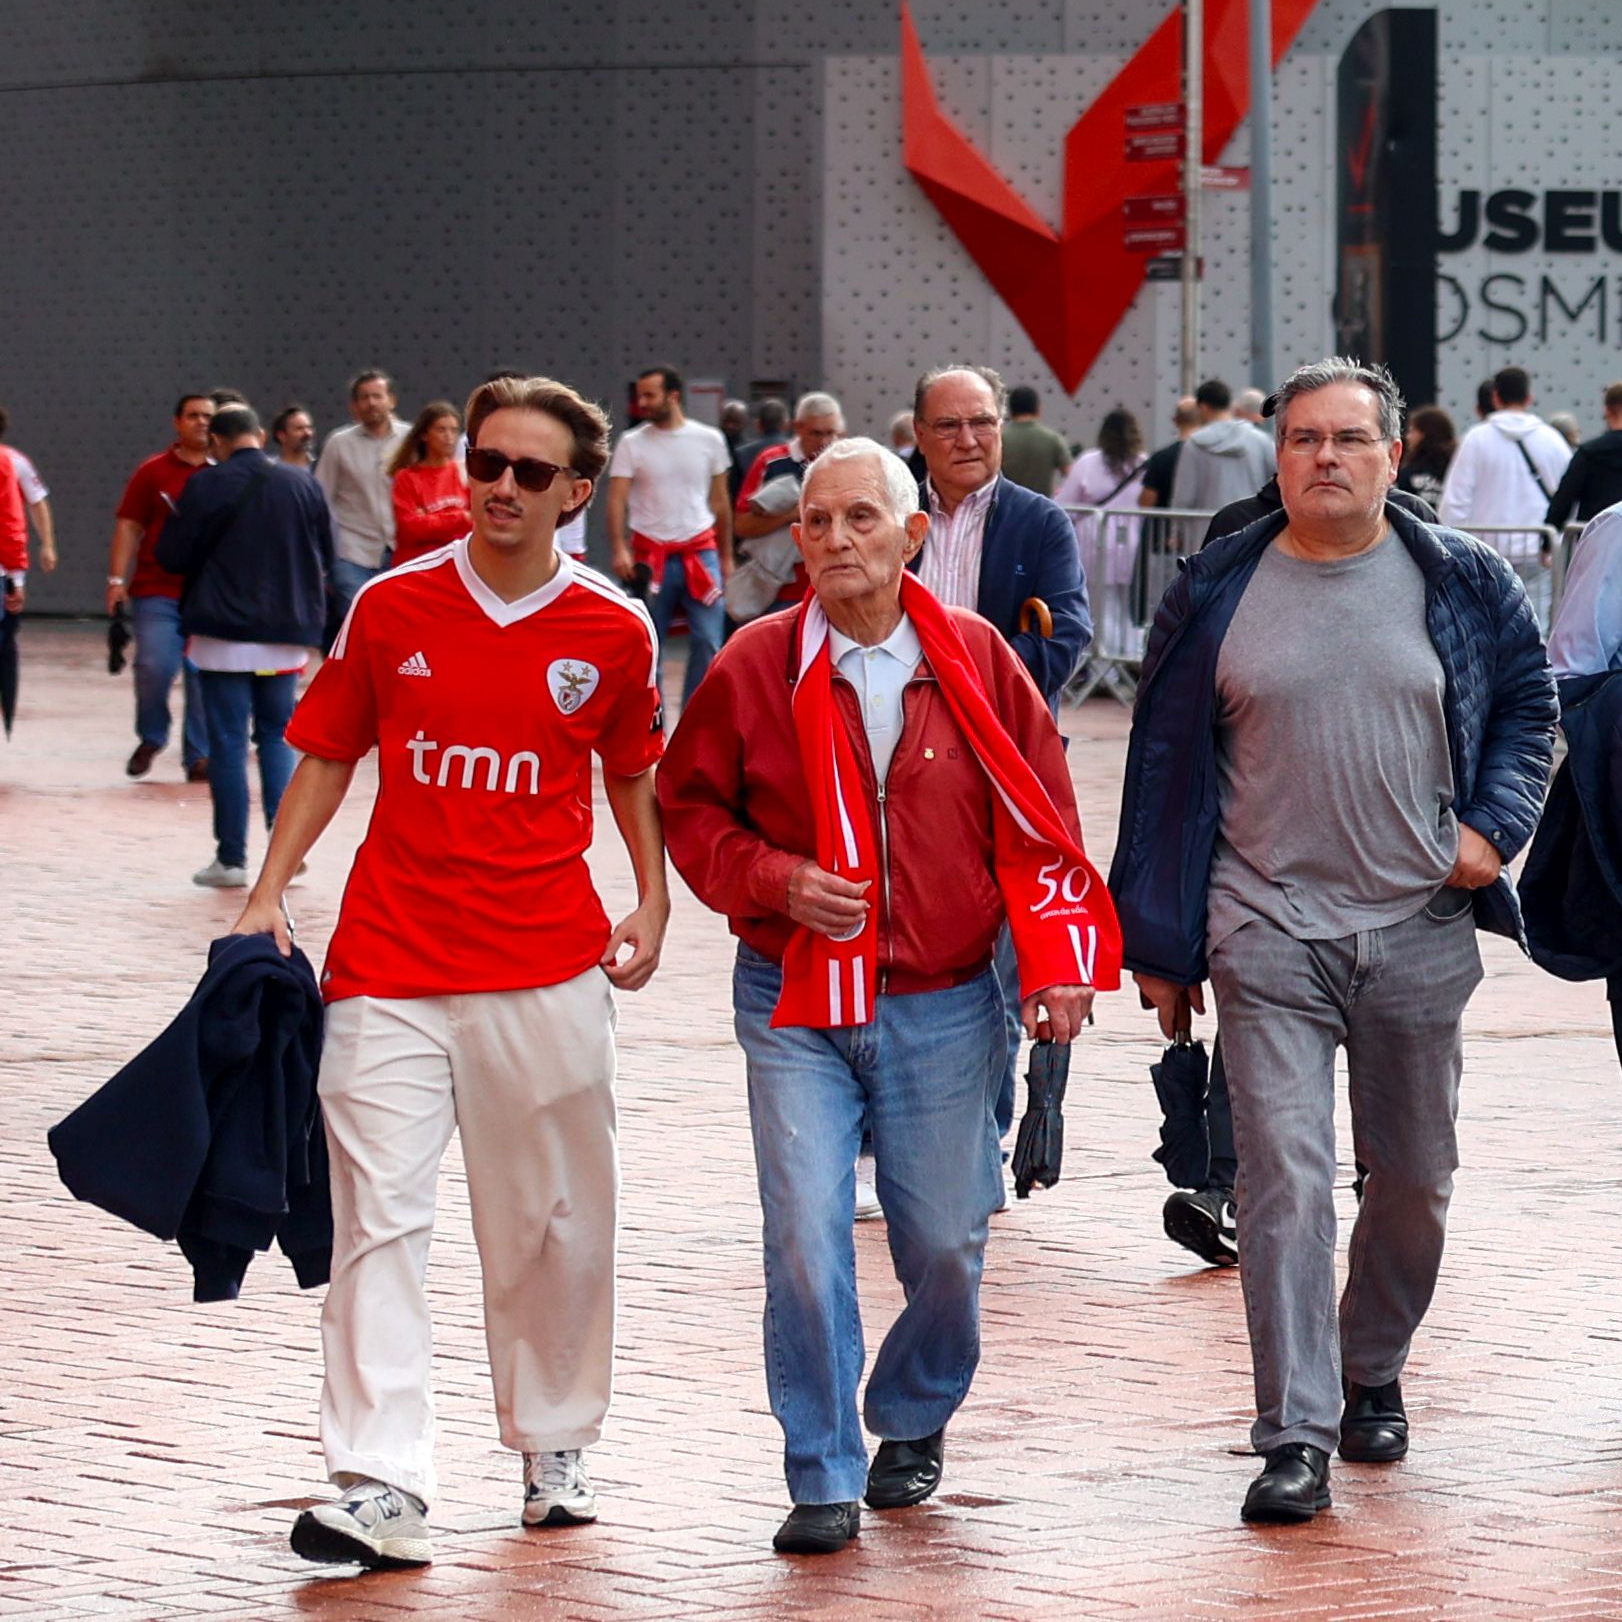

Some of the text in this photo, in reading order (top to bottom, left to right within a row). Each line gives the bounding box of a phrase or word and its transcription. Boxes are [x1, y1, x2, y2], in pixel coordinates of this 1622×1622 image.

[397, 666, 432, 677] adidas
[405, 730, 540, 795] tmn
[1029, 855, 1091, 912] 50
